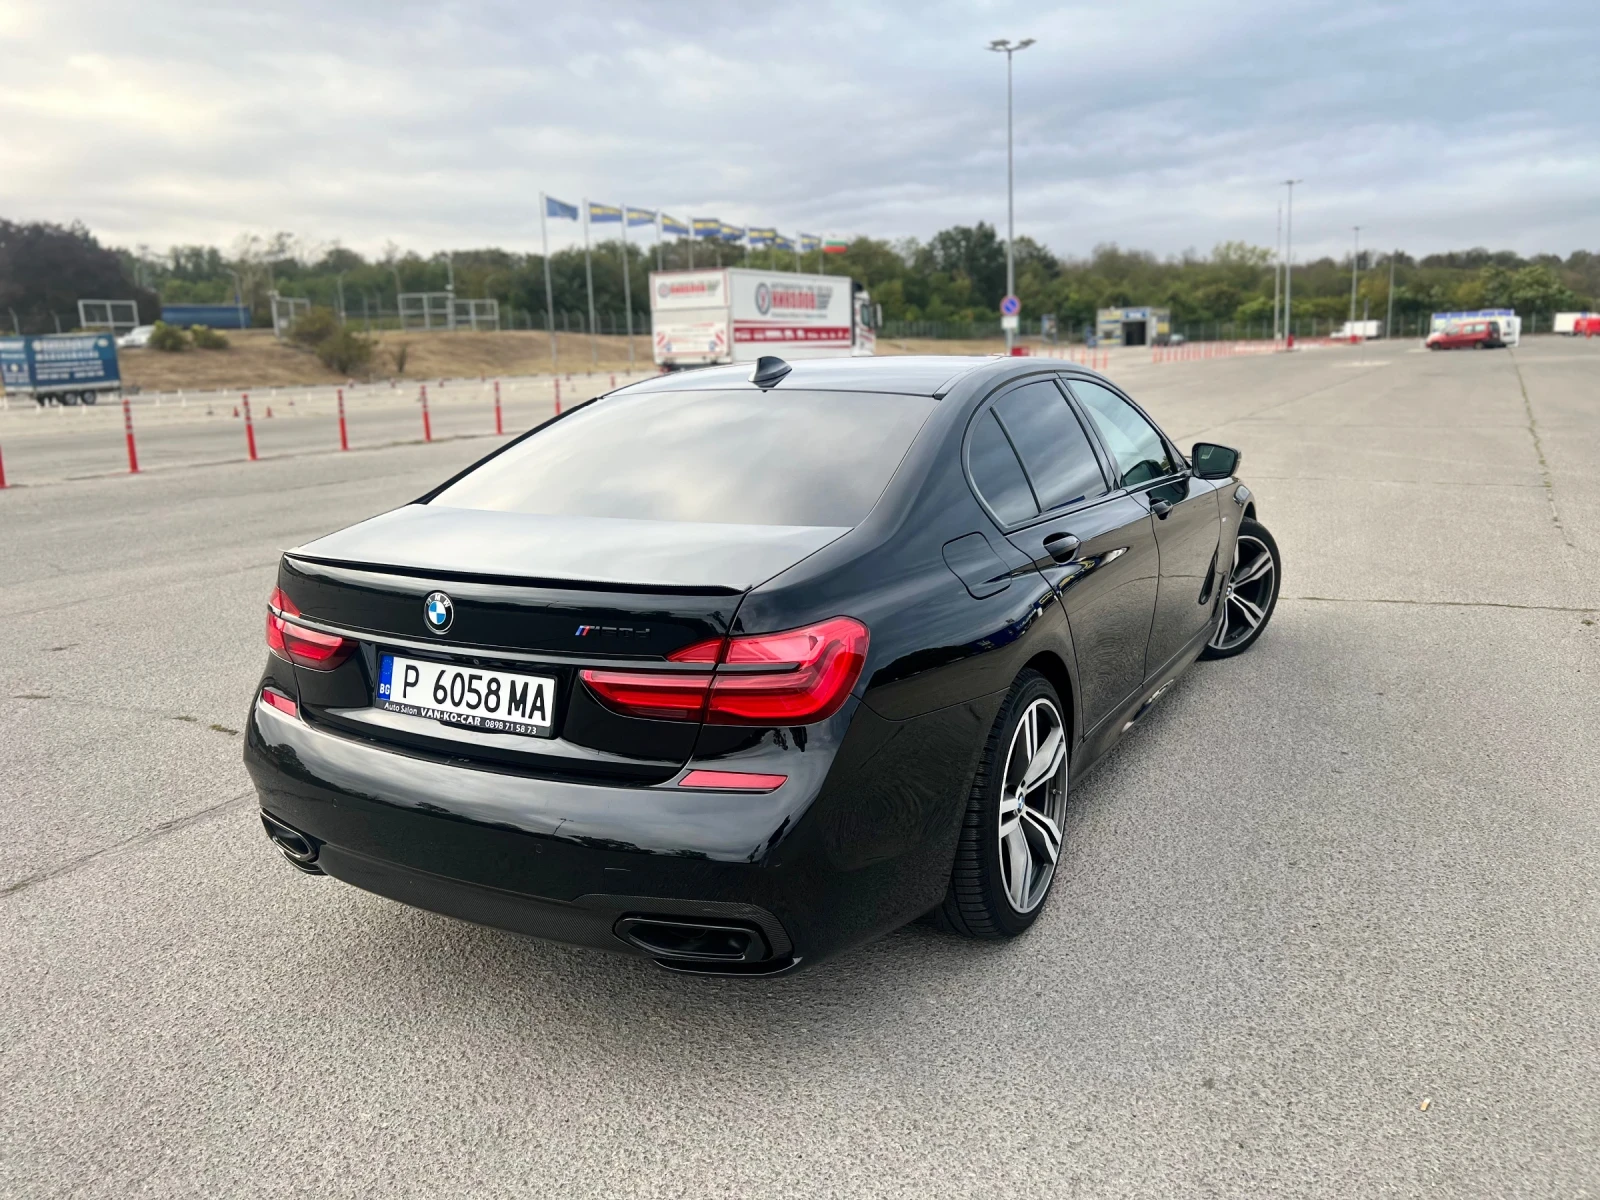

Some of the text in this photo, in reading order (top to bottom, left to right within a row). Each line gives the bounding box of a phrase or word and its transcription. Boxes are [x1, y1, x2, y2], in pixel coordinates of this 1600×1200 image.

[426, 593, 452, 608] BMW
[379, 683, 391, 695] BG
[402, 664, 547, 722] P 6058 MA
[384, 702, 400, 712] Auto
[400, 705, 418, 715] Salon
[485, 719, 504, 730] 0898
[505, 722, 514, 731] 71
[515, 724, 526, 733] 58
[527, 726, 537, 735] 73
